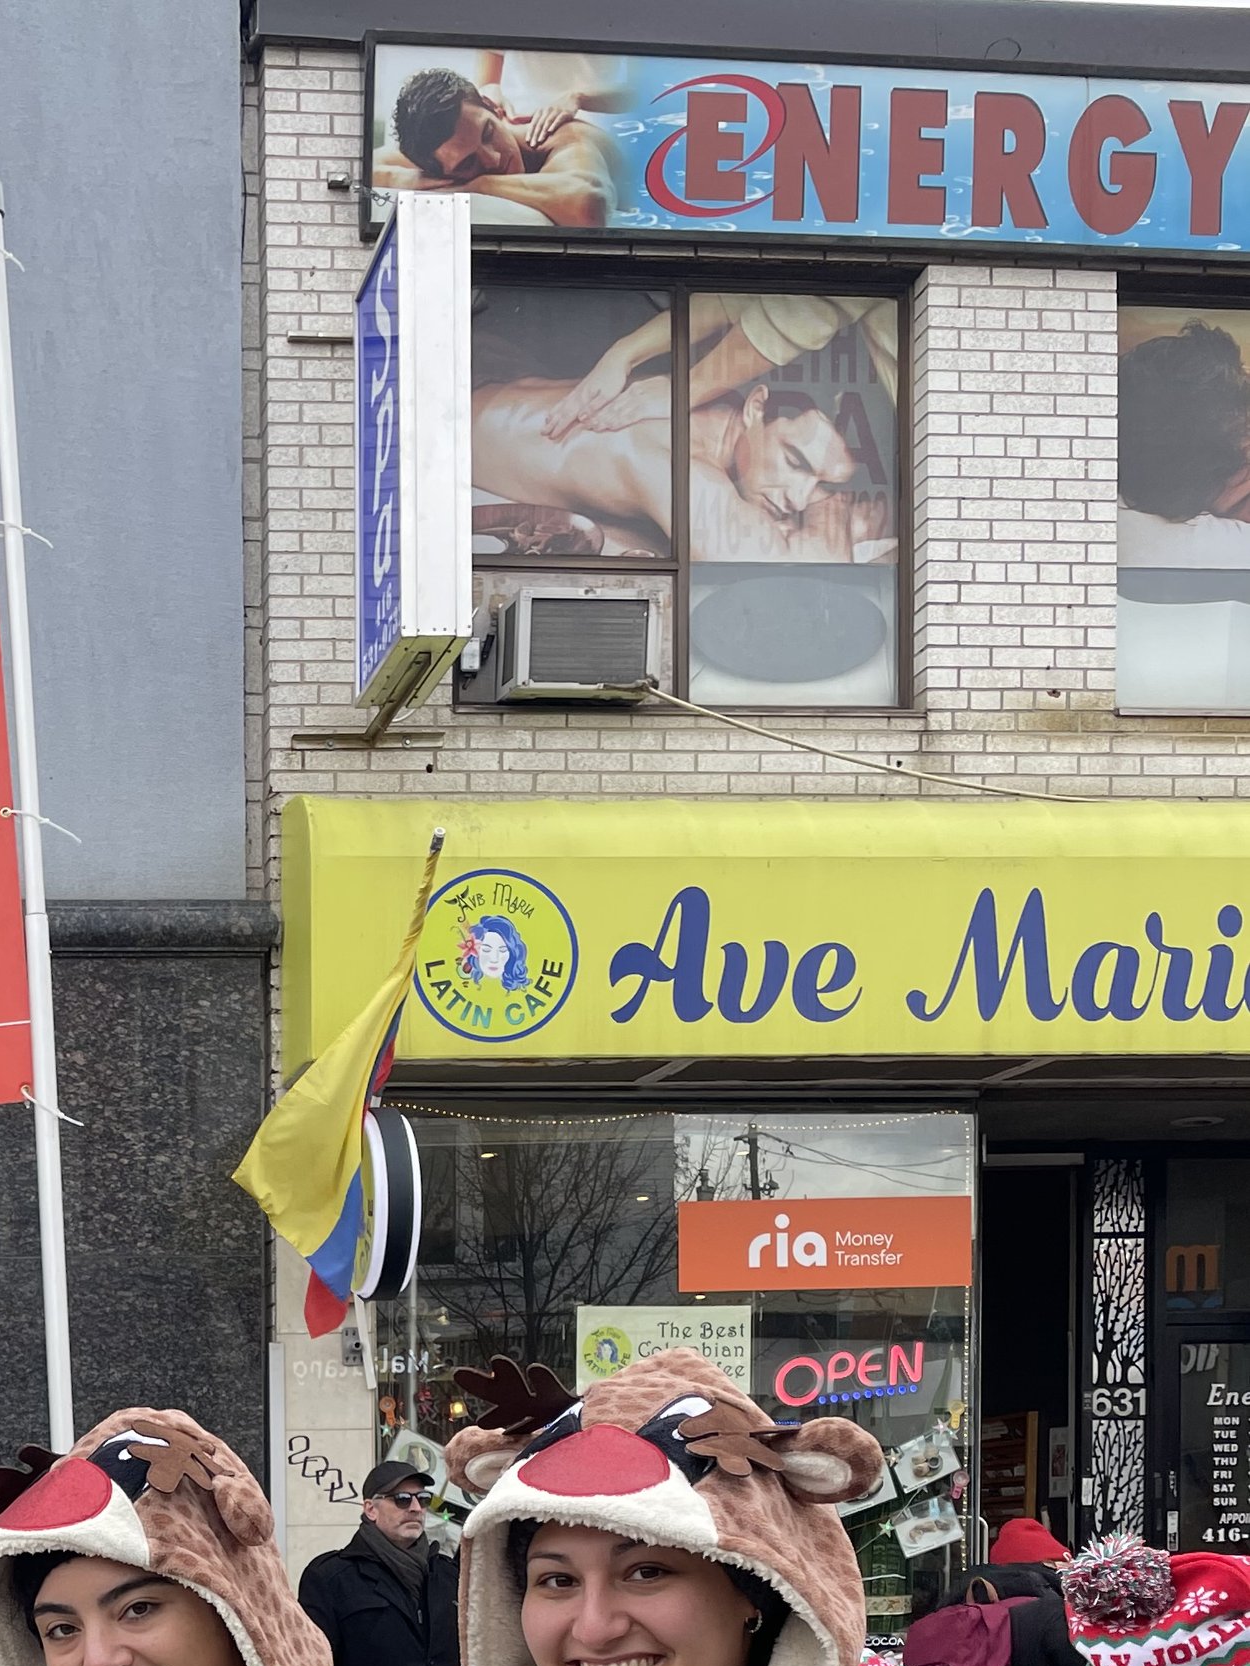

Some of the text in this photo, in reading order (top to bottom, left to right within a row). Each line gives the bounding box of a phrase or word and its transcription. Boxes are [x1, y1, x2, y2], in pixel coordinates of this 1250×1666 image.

[682, 80, 1250, 236] ENERGY
[609, 885, 1250, 1025] Ave Mari
[425, 959, 563, 1029] LATIN CAFE
[748, 1213, 894, 1268] ria Money
[835, 1249, 903, 1267] Transfer
[657, 1321, 746, 1340] The Best
[775, 1340, 924, 1407] OPEN
[1092, 1388, 1147, 1417] 631
[1213, 1416, 1240, 1426] MON
[1213, 1430, 1237, 1439] TUE
[1213, 1443, 1239, 1452] WED
[1213, 1457, 1238, 1466] THU
[1213, 1470, 1232, 1479] FRI
[1213, 1484, 1236, 1493] SAT
[1213, 1497, 1237, 1506] SUN
[864, 1636, 905, 1646] COCOA
